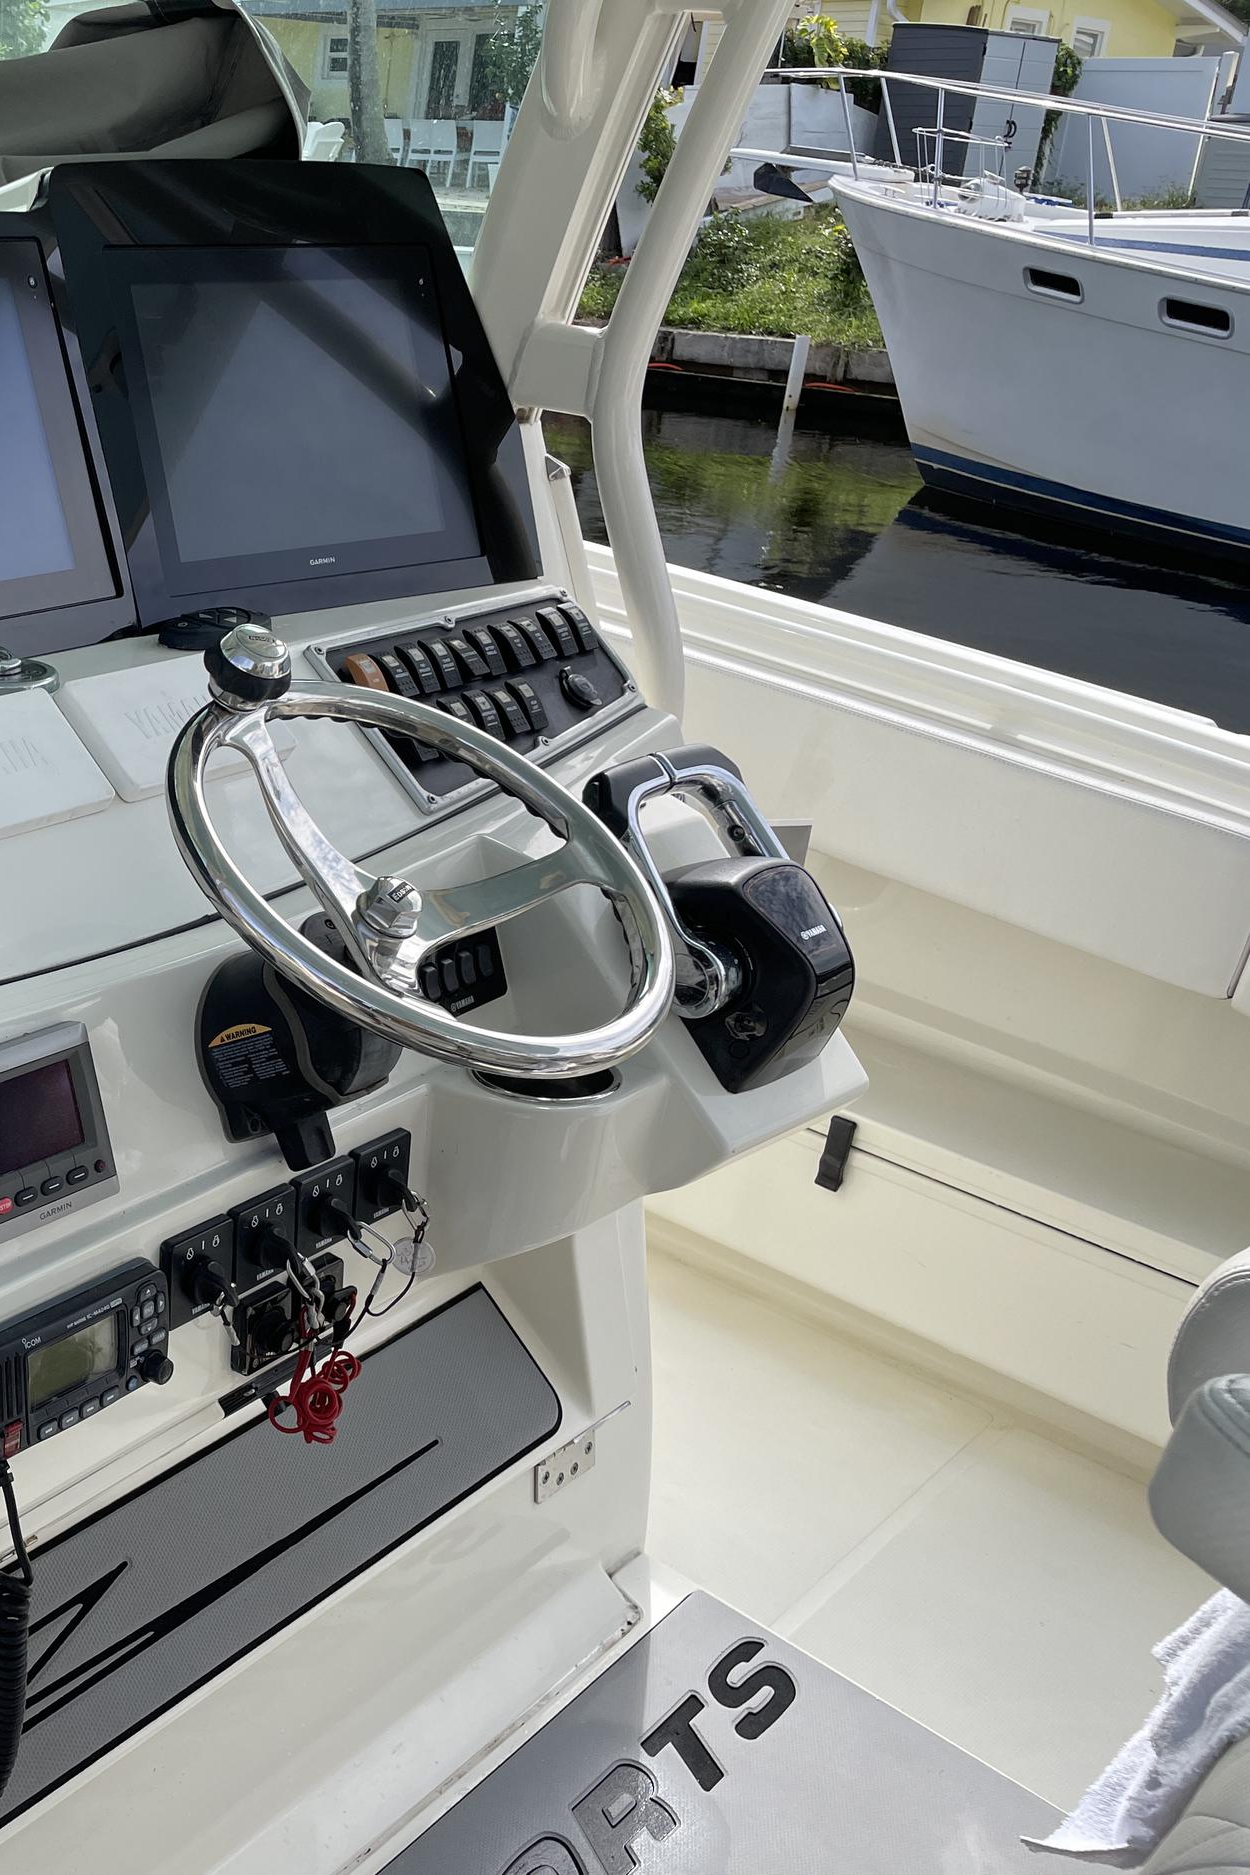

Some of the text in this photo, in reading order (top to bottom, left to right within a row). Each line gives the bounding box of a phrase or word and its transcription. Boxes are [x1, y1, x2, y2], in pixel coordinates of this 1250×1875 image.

[310, 556, 335, 566] GARMIN
[224, 1026, 257, 1040] WARNING
[40, 1202, 72, 1220] GARMIN
